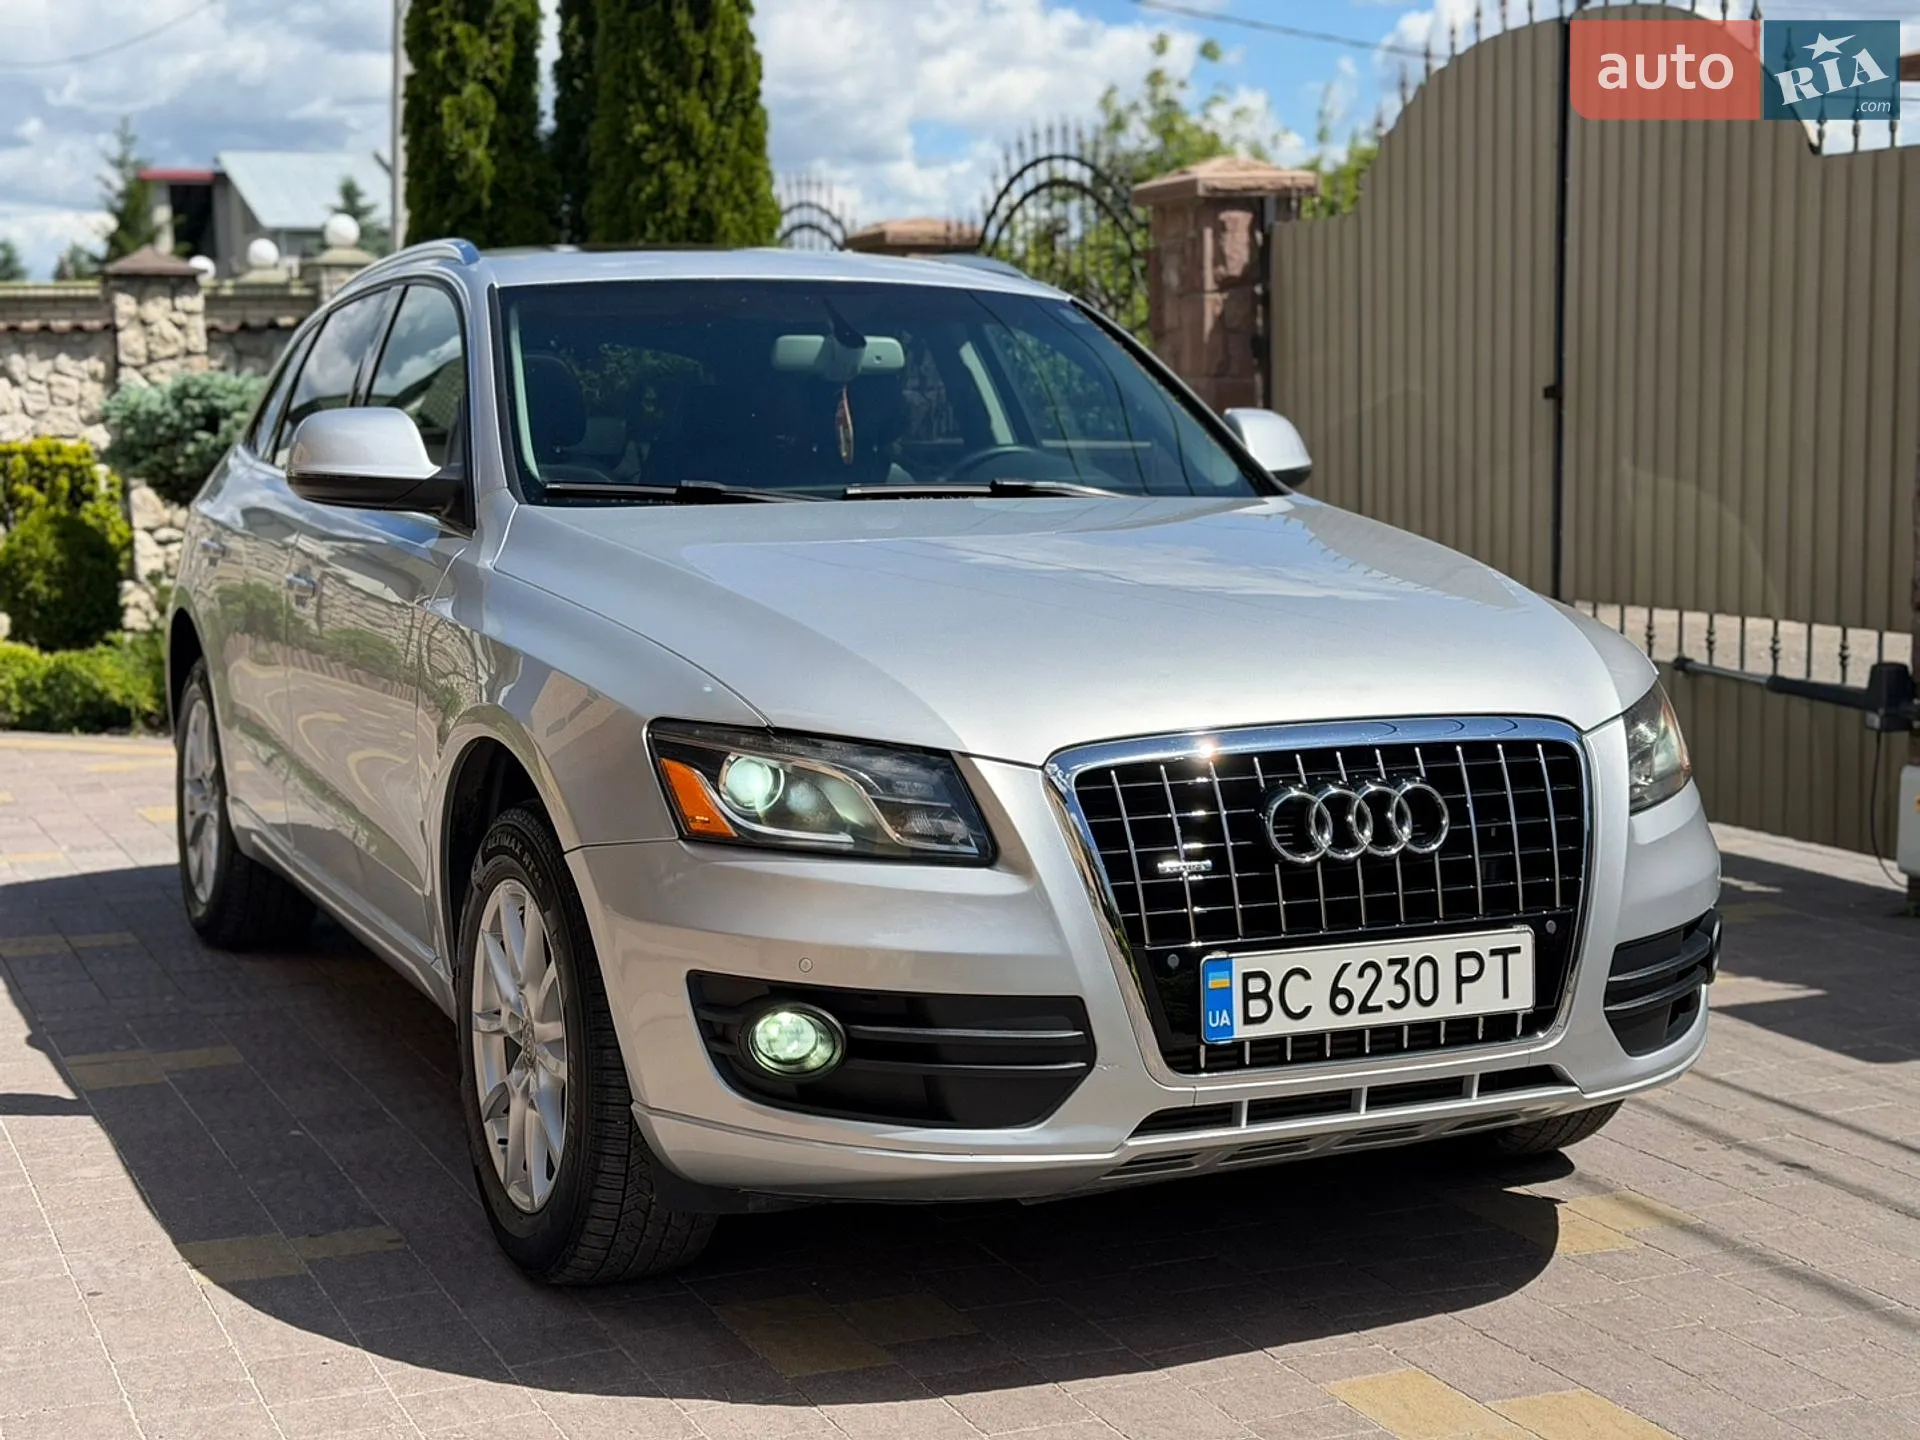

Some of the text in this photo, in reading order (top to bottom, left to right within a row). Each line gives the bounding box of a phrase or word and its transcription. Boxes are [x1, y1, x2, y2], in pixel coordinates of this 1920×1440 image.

[1241, 946, 1522, 1026] BC 6230 PT
[1208, 1010, 1231, 1028] UA
